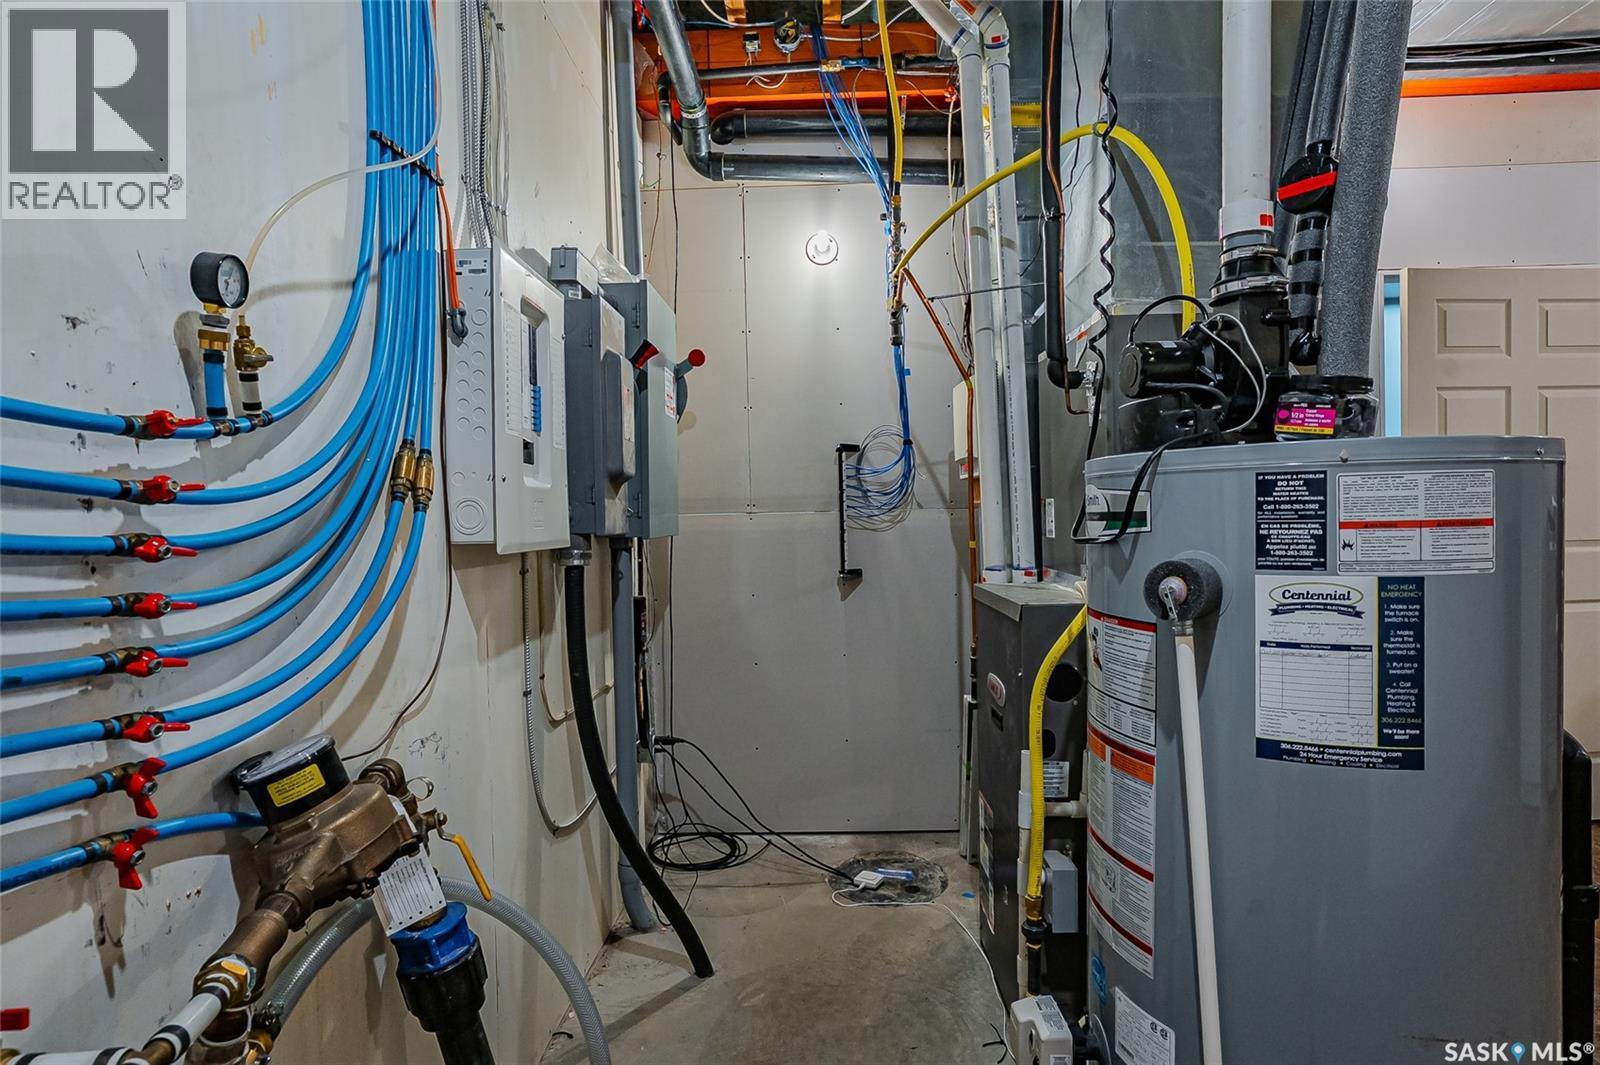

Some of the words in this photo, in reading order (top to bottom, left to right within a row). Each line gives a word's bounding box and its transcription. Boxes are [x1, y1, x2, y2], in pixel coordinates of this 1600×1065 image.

[1282, 589, 1352, 601] Centennial
[1381, 716, 1422, 724] 306.222.8466
[1280, 742, 1319, 753] 306.222.8466
[1325, 748, 1403, 758] centennialplumbing.com
[1282, 755, 1307, 763] Plumbing
[1346, 761, 1367, 769] Cooling
[1308, 752, 1324, 760] Hour
[1324, 754, 1360, 763] Emergency
